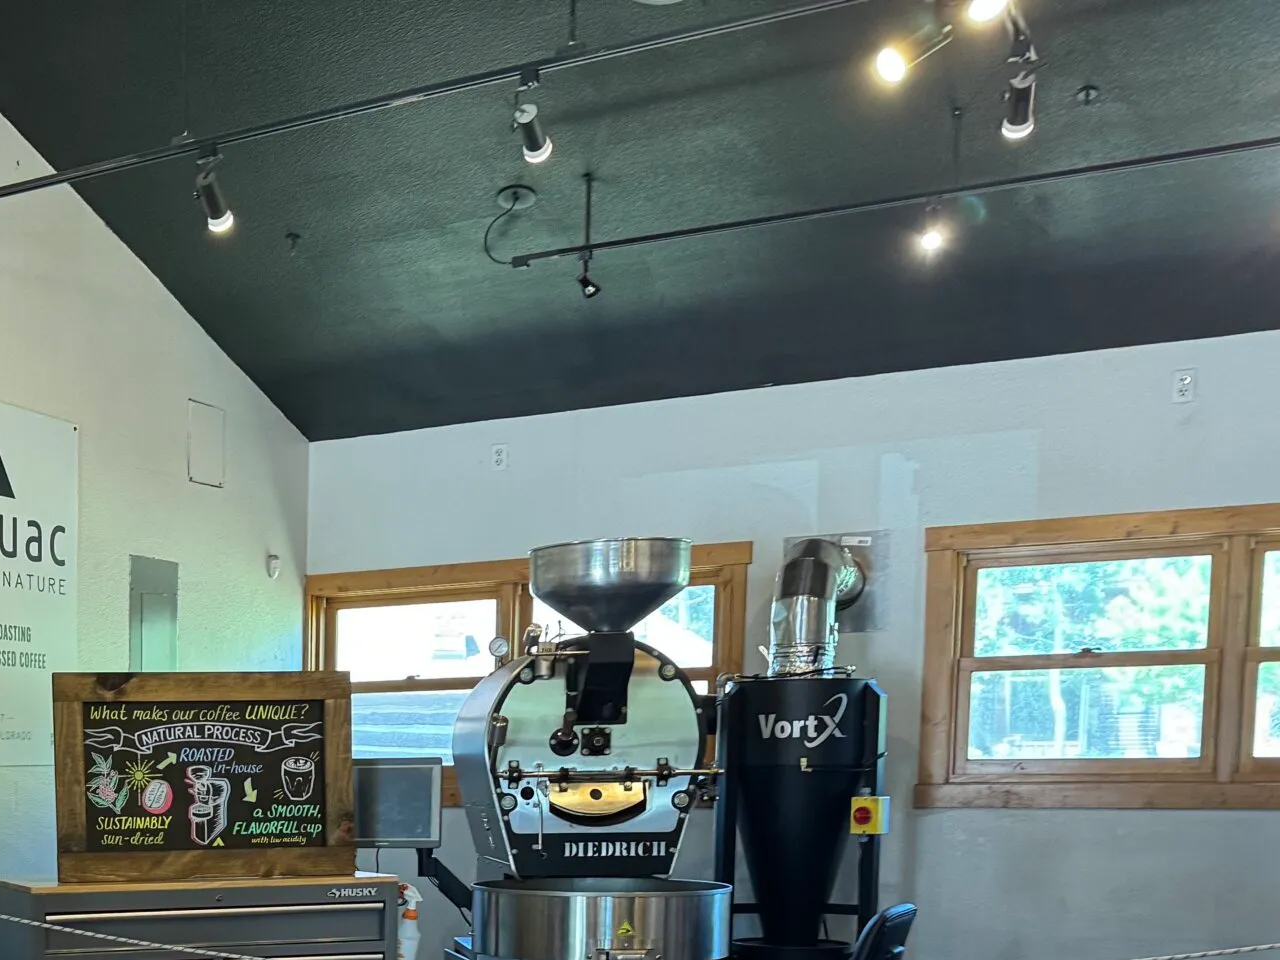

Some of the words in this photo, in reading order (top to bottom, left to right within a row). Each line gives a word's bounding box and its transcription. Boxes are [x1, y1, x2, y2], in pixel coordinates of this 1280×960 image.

[2, 571, 67, 595] NATURE
[19, 652, 47, 669] COFFEE
[89, 704, 128, 720] What
[132, 705, 169, 722] makes
[172, 709, 198, 720] our
[199, 704, 241, 721] coffee
[245, 703, 310, 720] UNIQUE?
[141, 725, 202, 746] NATURAL
[204, 725, 261, 744] PROCESS
[179, 747, 235, 762] ROASTED
[213, 761, 264, 774] in-house
[253, 808, 264, 817] a
[95, 816, 173, 831] SUSTAINABLY
[232, 820, 299, 836] FLAVORFUL
[300, 823, 323, 838] cup
[101, 831, 165, 846] sun-dried
[251, 836, 269, 844] with
[282, 835, 307, 845] acidity
[563, 841, 667, 857] DIEDRICH
[340, 887, 378, 897] HUSKY
